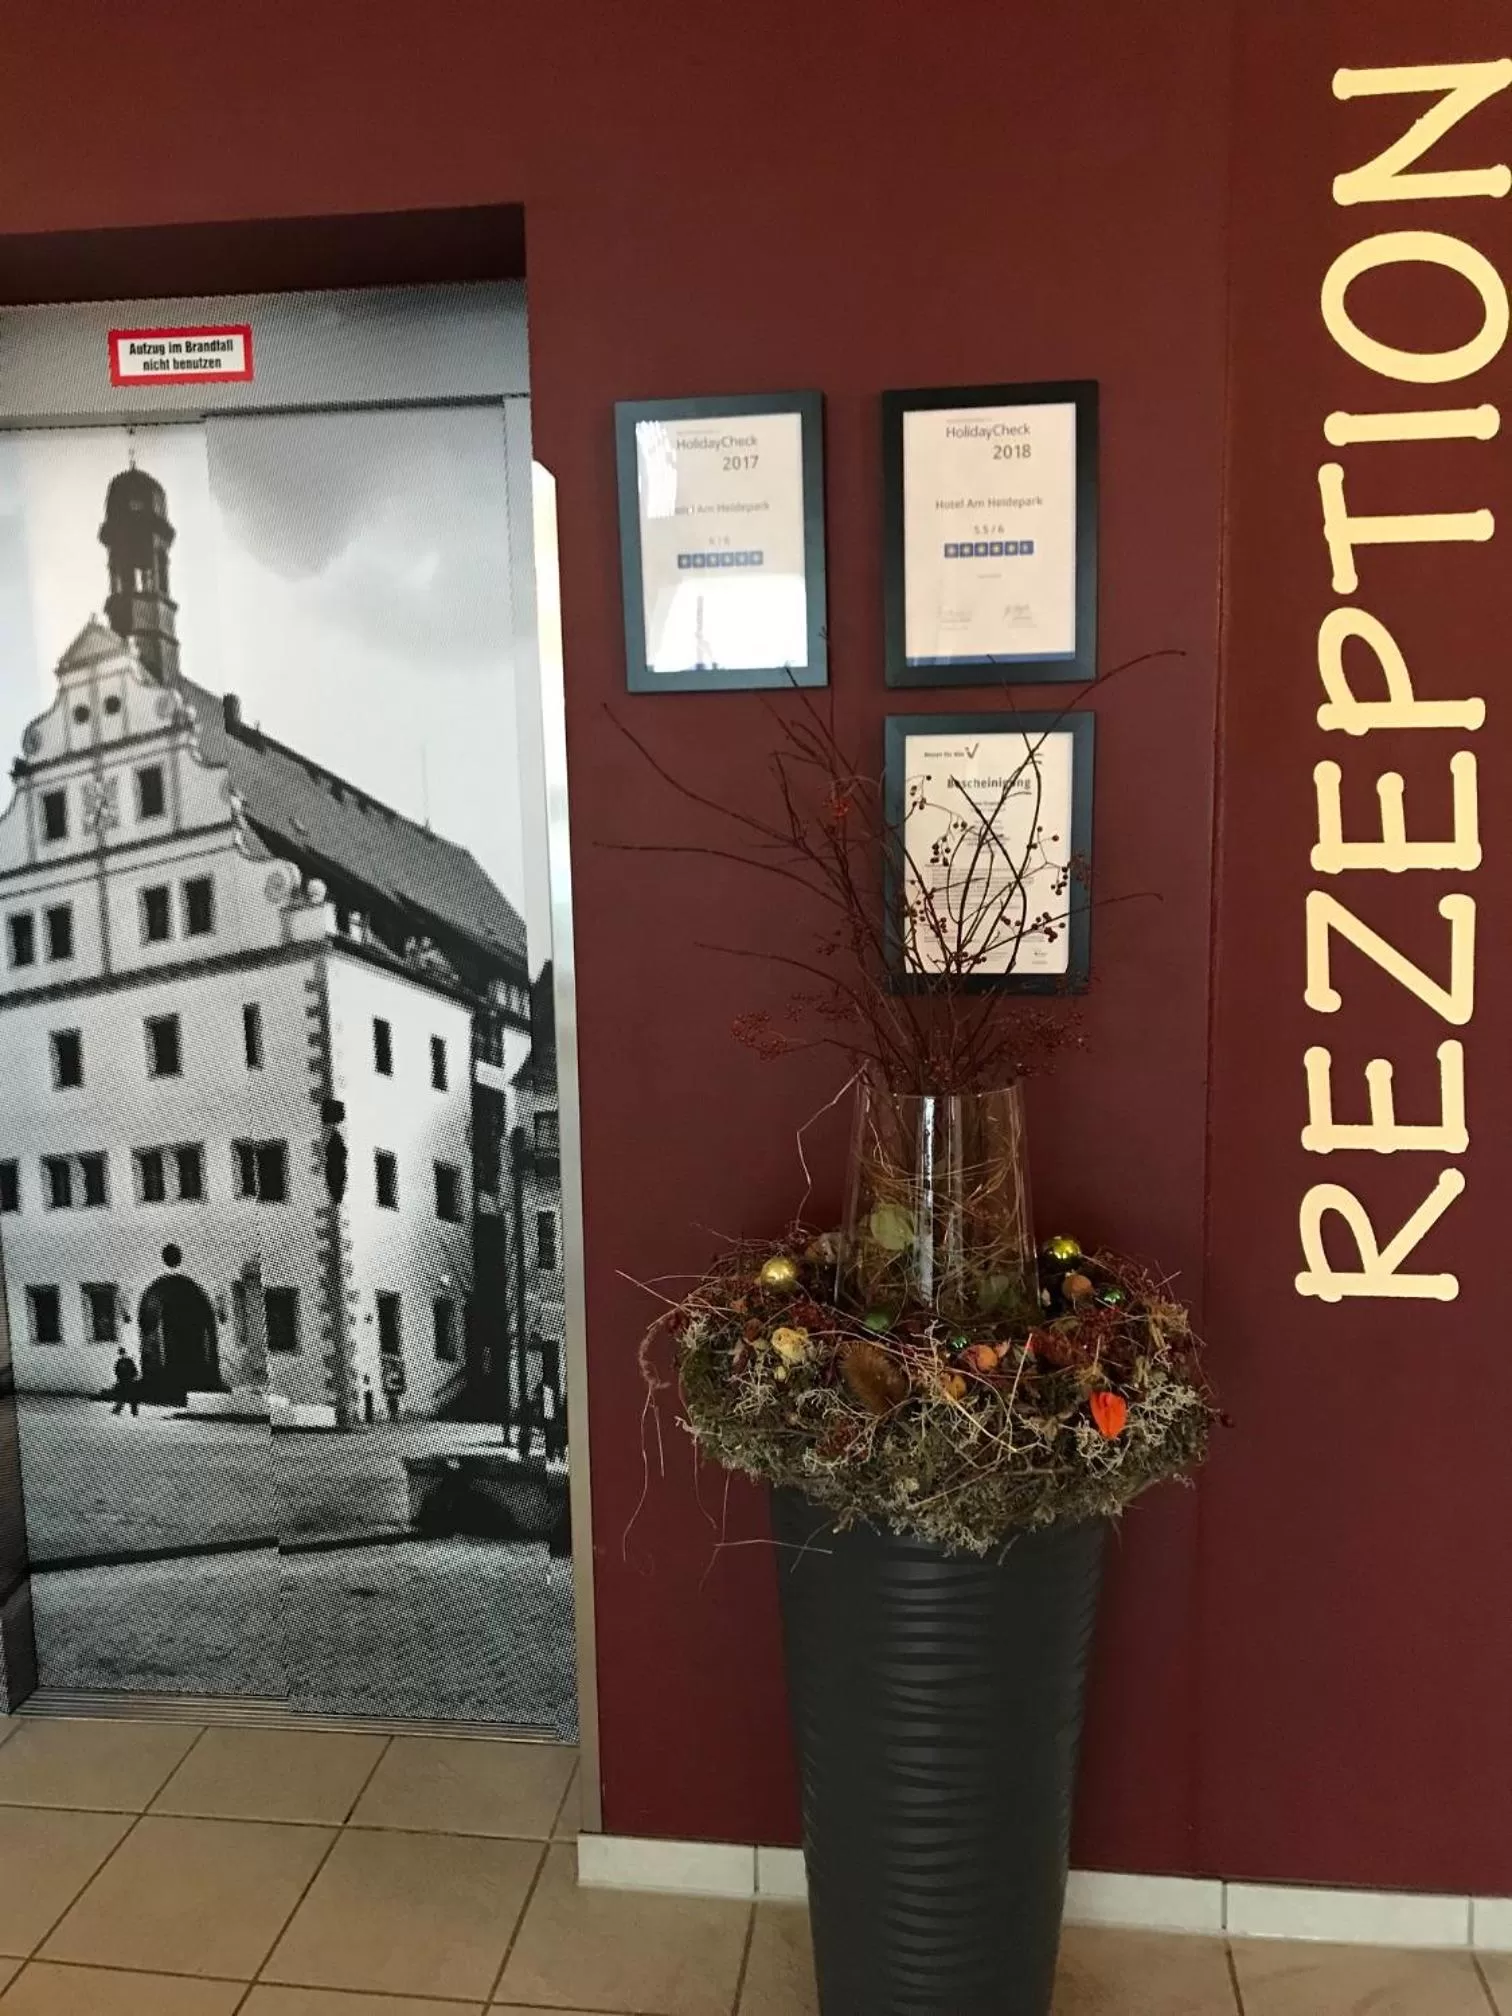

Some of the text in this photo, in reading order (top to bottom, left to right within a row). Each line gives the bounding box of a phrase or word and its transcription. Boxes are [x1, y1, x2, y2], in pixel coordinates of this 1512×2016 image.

[129, 339, 234, 356] Aufzug im Brandfall
[143, 357, 222, 371] nicht benutzen
[946, 422, 1031, 440] HolidayCheck
[676, 435, 758, 452] HolidayCheck
[993, 443, 1032, 460] 2018
[722, 455, 760, 471] 2017
[935, 497, 965, 509] Hotel
[967, 498, 985, 508] Am
[1294, 58, 1512, 1302] REZEPTION
